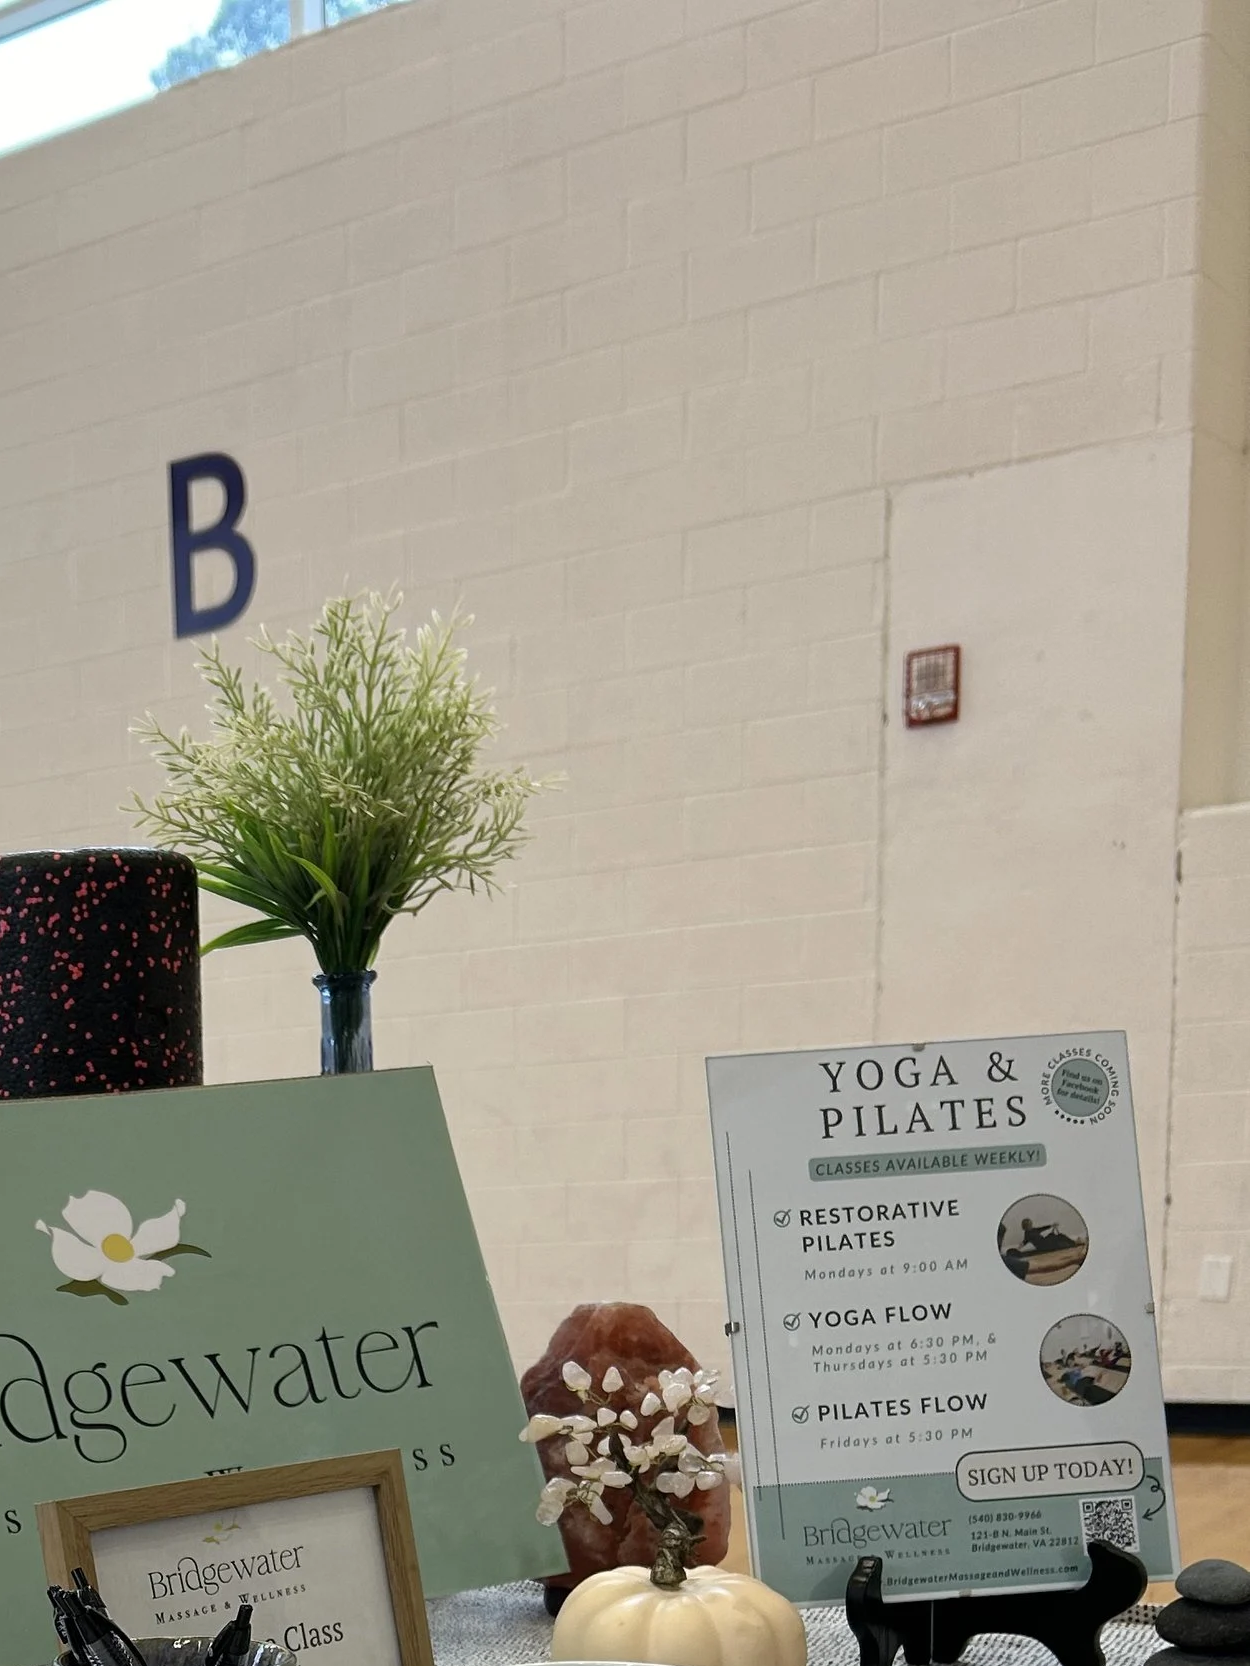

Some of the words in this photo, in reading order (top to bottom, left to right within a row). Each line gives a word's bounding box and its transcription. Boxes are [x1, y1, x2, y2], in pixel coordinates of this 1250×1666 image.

[166, 451, 258, 641] B
[1048, 1048, 1091, 1069] CLASSES
[818, 1055, 959, 1094] YOGA
[987, 1052, 1018, 1083] &
[1095, 1053, 1119, 1097] COMING
[1041, 1072, 1052, 1106] MORE
[819, 1095, 1027, 1140] PILATES
[1090, 1100, 1116, 1125] SOON
[815, 1160, 881, 1176] CLASSES
[885, 1153, 968, 1172] AVAILABLE
[974, 1150, 1041, 1166] WEEKLY!
[800, 1199, 960, 1227] RESTORATIVE
[802, 1230, 895, 1253] PILATES
[804, 1266, 873, 1281] Mondays
[880, 1265, 895, 1276] at
[903, 1260, 938, 1274] 9:00
[945, 1258, 969, 1271] AM
[808, 1308, 876, 1329] YOGA
[885, 1303, 952, 1324] FLOW
[812, 1342, 880, 1357] Mondays
[887, 1340, 902, 1351] at
[910, 1336, 944, 1350] 6:30
[952, 1334, 980, 1347] PM,
[987, 1332, 997, 1344] &
[813, 1358, 893, 1373] Thursdays
[900, 1356, 915, 1367] at
[923, 1352, 957, 1366] 5:30
[965, 1350, 987, 1362] PM
[818, 1398, 911, 1422] PILATES
[920, 1393, 987, 1414] FLOW
[820, 1435, 878, 1449] Fridays
[885, 1434, 900, 1445] at
[909, 1430, 943, 1443] 5:30
[951, 1428, 973, 1440] PM
[968, 1466, 1016, 1487] SIGN
[1022, 1464, 1049, 1482] UP
[1054, 1458, 1133, 1480] TODAY!
[968, 1513, 994, 1525] (540)
[996, 1510, 1042, 1522] 830-9966
[803, 1517, 952, 1549] Bridgewater
[971, 1530, 1000, 1541] 121-B
[1014, 1527, 1038, 1537] Main
[971, 1540, 1030, 1553] Bridgewater,
[1033, 1539, 1047, 1548] VA
[1049, 1536, 1079, 1547] 22812
[884, 1548, 950, 1559] WELLNESS
[148, 1544, 304, 1600] Bridgewater
[155, 1604, 218, 1625] MASSAGE
[224, 1601, 231, 1610] &
[238, 1584, 306, 1606] WELLNESS
[284, 1619, 344, 1653] Class
